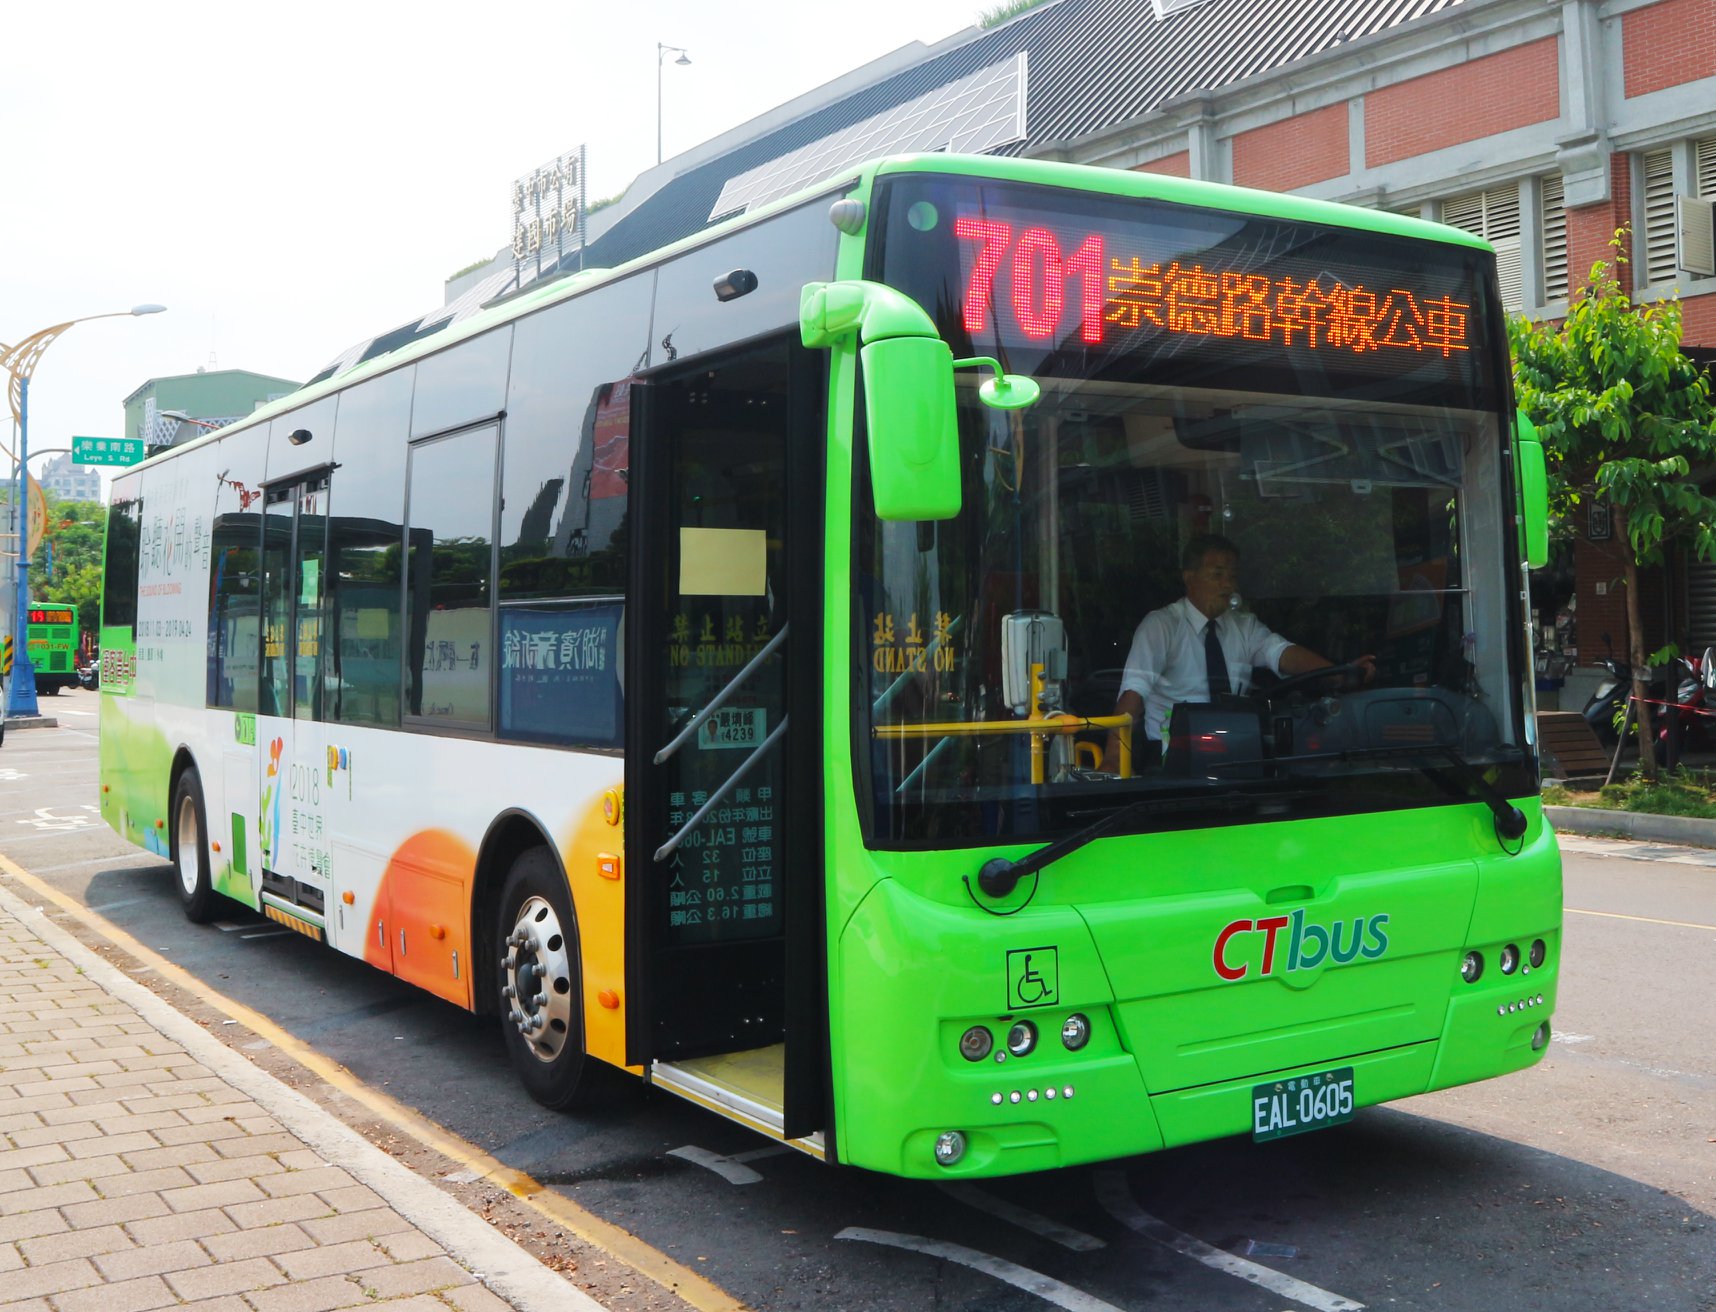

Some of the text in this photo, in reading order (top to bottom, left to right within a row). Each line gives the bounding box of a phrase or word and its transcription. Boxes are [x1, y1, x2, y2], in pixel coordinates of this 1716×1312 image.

[512, 198, 577, 260] 建國市場
[955, 218, 1470, 357] 701 崇德路幹線公車
[672, 613, 771, 643] 禁止站立
[671, 644, 690, 666] NO
[725, 727, 754, 741] 4239
[292, 763, 319, 806] 2018
[1212, 907, 1390, 981] CTbus
